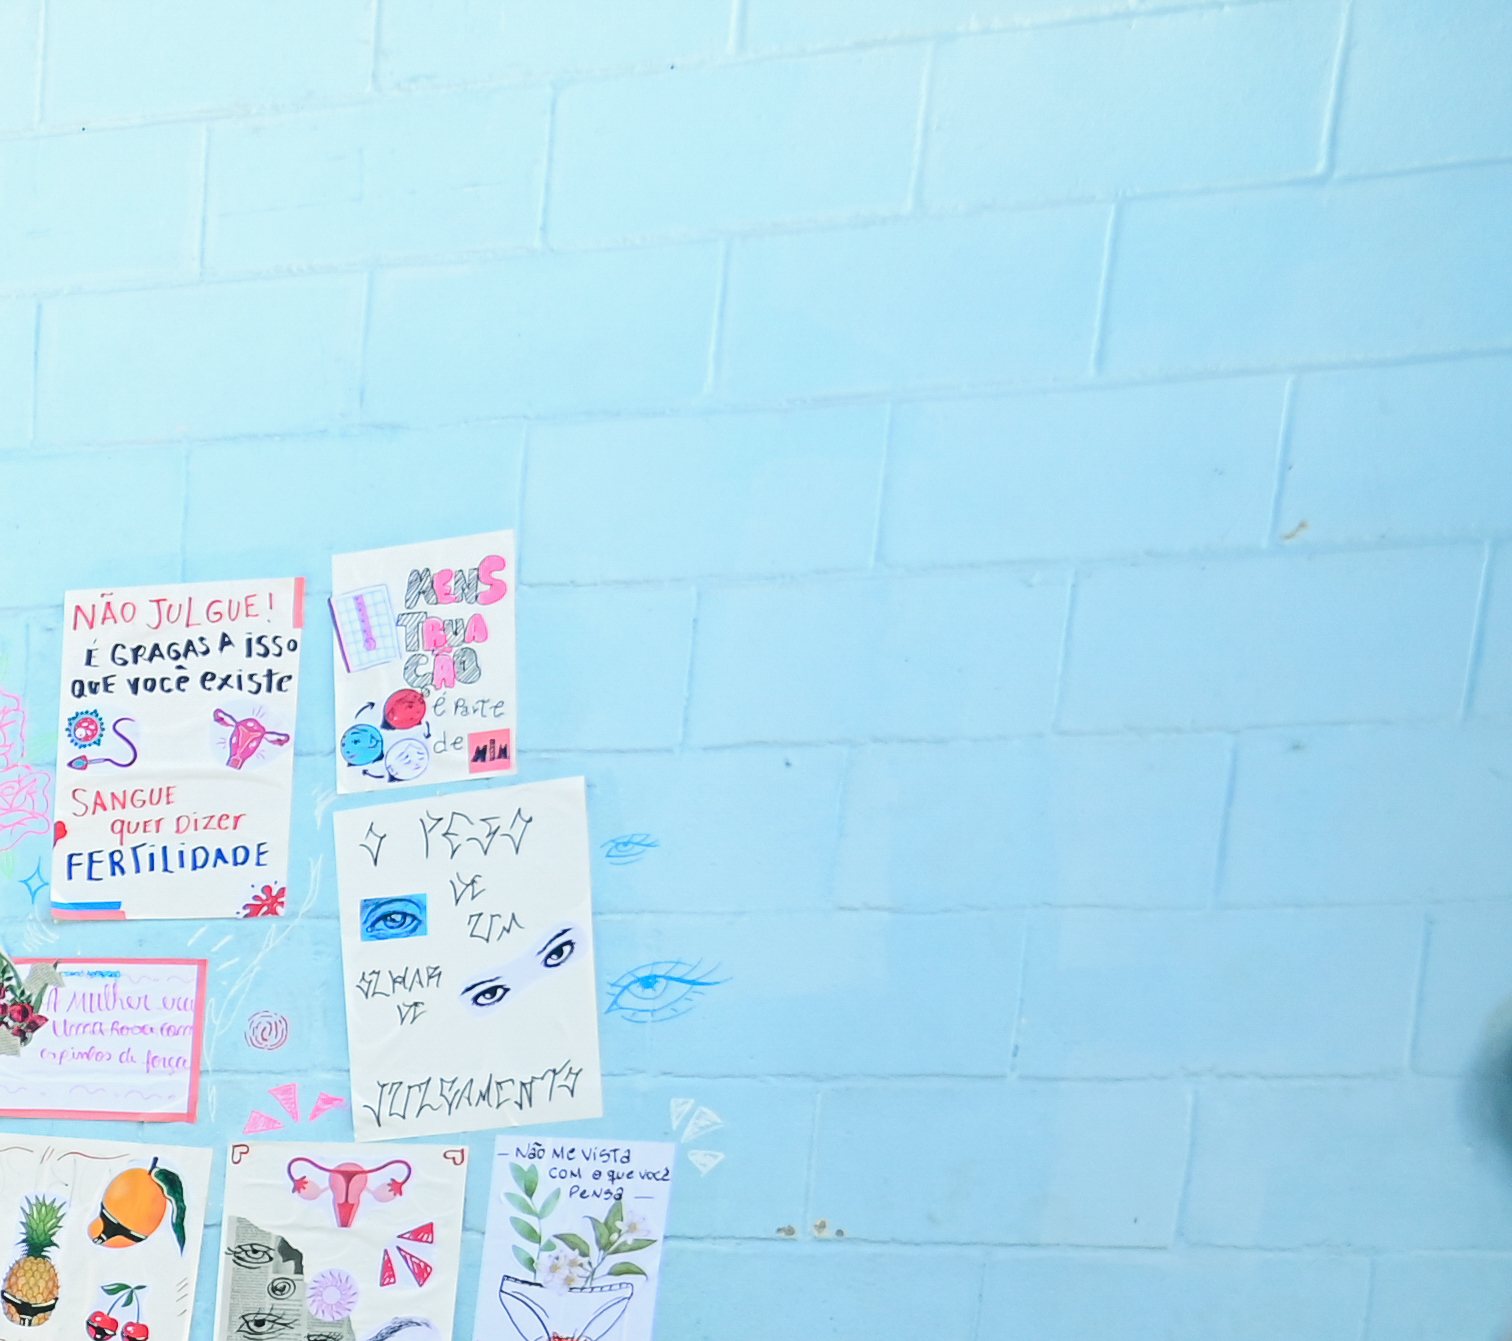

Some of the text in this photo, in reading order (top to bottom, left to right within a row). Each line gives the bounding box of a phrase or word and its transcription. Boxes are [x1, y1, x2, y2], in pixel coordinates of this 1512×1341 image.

[73, 592, 274, 631] NÃO JULGUE!
[218, 631, 235, 654] A
[433, 729, 465, 754] de
[70, 786, 176, 818] SANGUE
